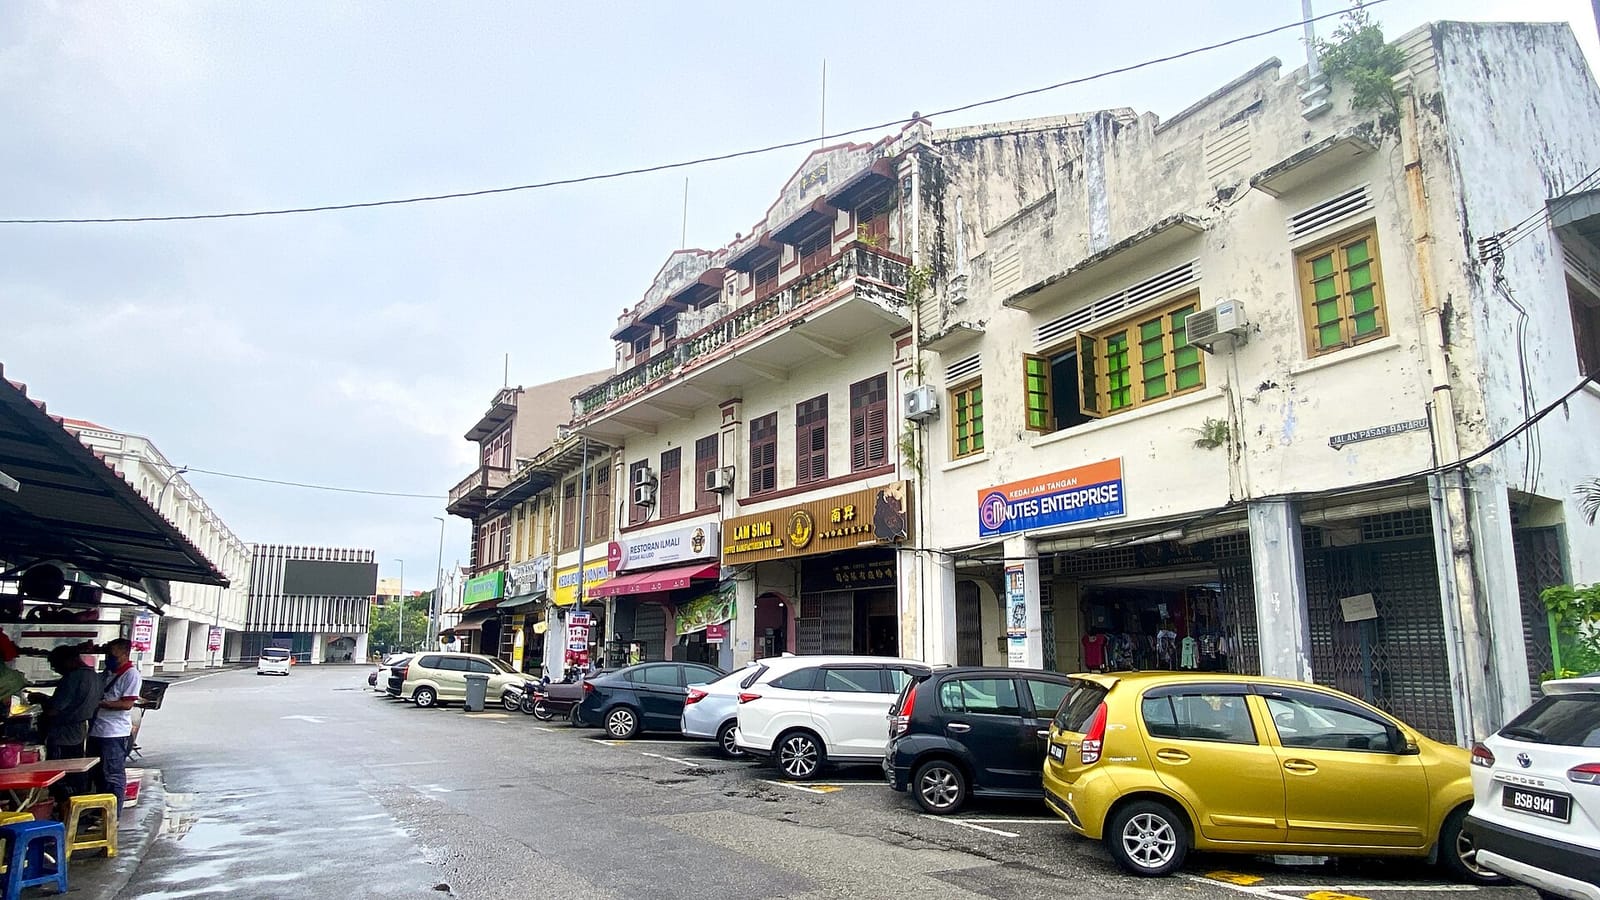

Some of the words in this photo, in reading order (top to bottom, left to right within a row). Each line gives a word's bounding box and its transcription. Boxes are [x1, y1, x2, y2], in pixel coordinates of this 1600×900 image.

[1332, 433, 1358, 445] JALAN
[1360, 427, 1387, 439] PASAR
[1390, 419, 1426, 433] BAHARU
[1009, 489, 1030, 499] KEDAI
[1031, 484, 1046, 494] JAM
[1046, 478, 1077, 491] TANGAN
[1041, 484, 1119, 514] ENTERPRISE
[733, 525, 750, 541] LAM
[751, 520, 772, 538] SING
[630, 542, 660, 554] RESTORAN
[660, 537, 680, 549] ILMALI
[1514, 791, 1533, 809] BSB
[1533, 796, 1554, 814] 9141
